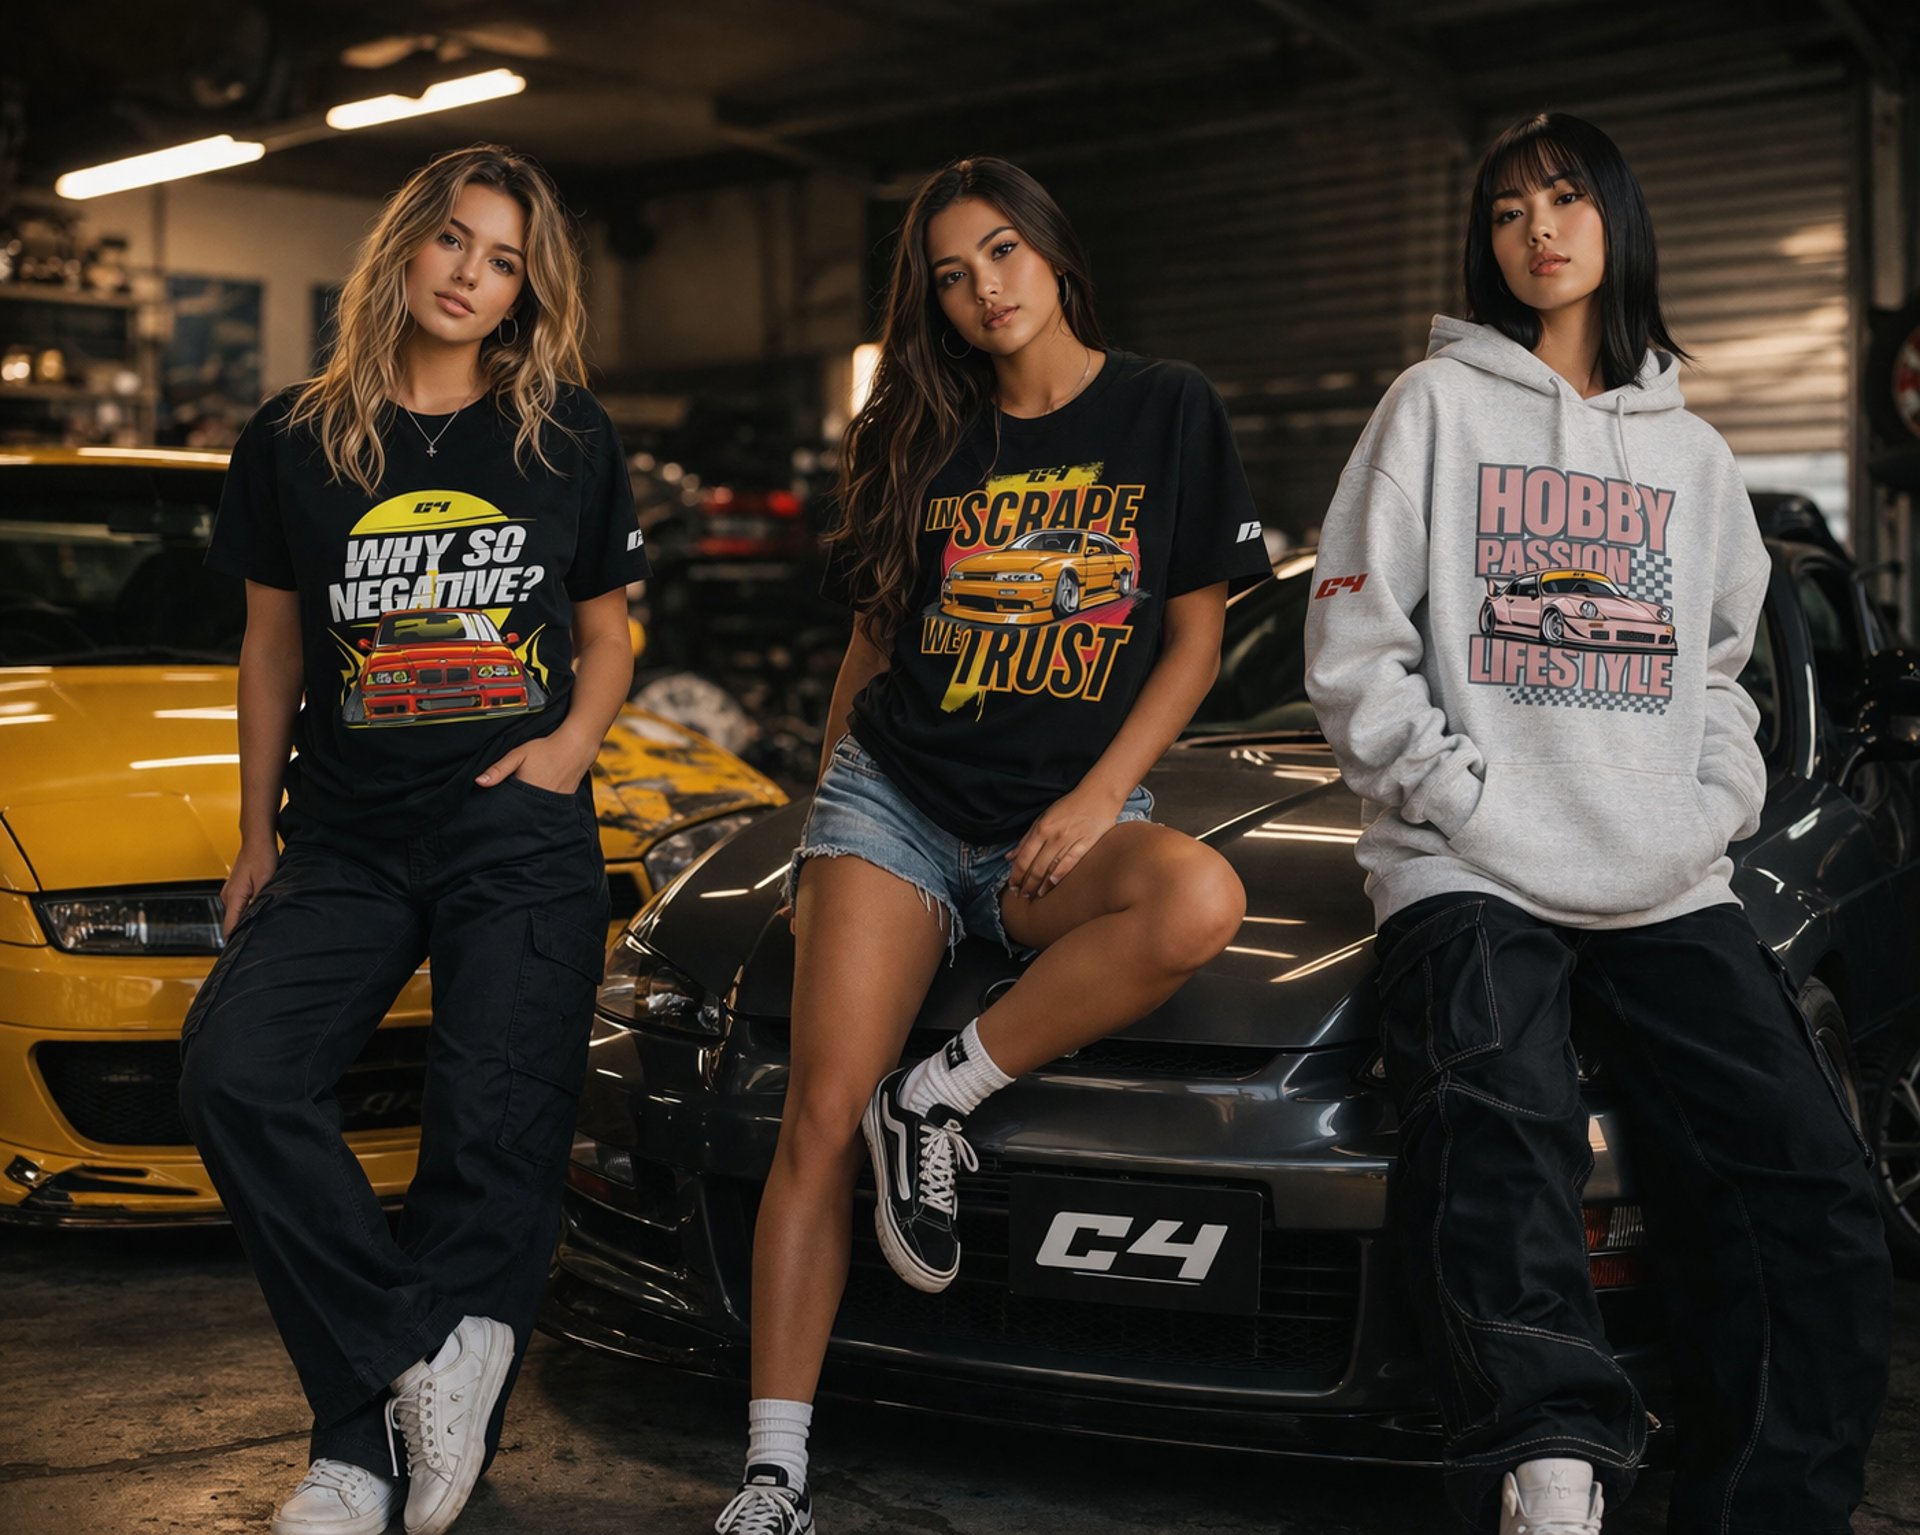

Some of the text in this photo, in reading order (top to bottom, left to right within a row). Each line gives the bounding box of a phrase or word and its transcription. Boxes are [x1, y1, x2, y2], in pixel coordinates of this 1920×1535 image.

[413, 501, 452, 513] C4
[925, 484, 1146, 548] IN SCRAPE
[1476, 462, 1676, 555] HOBBY
[345, 525, 527, 579] WHY SO
[1474, 537, 1632, 587] PASSION
[329, 565, 545, 624] NEGATIVE?
[1314, 573, 1369, 600] C4
[921, 616, 1133, 701] WE TRUST
[1467, 633, 1674, 699] LIFESTYLE
[1035, 1211, 1229, 1280] C4
